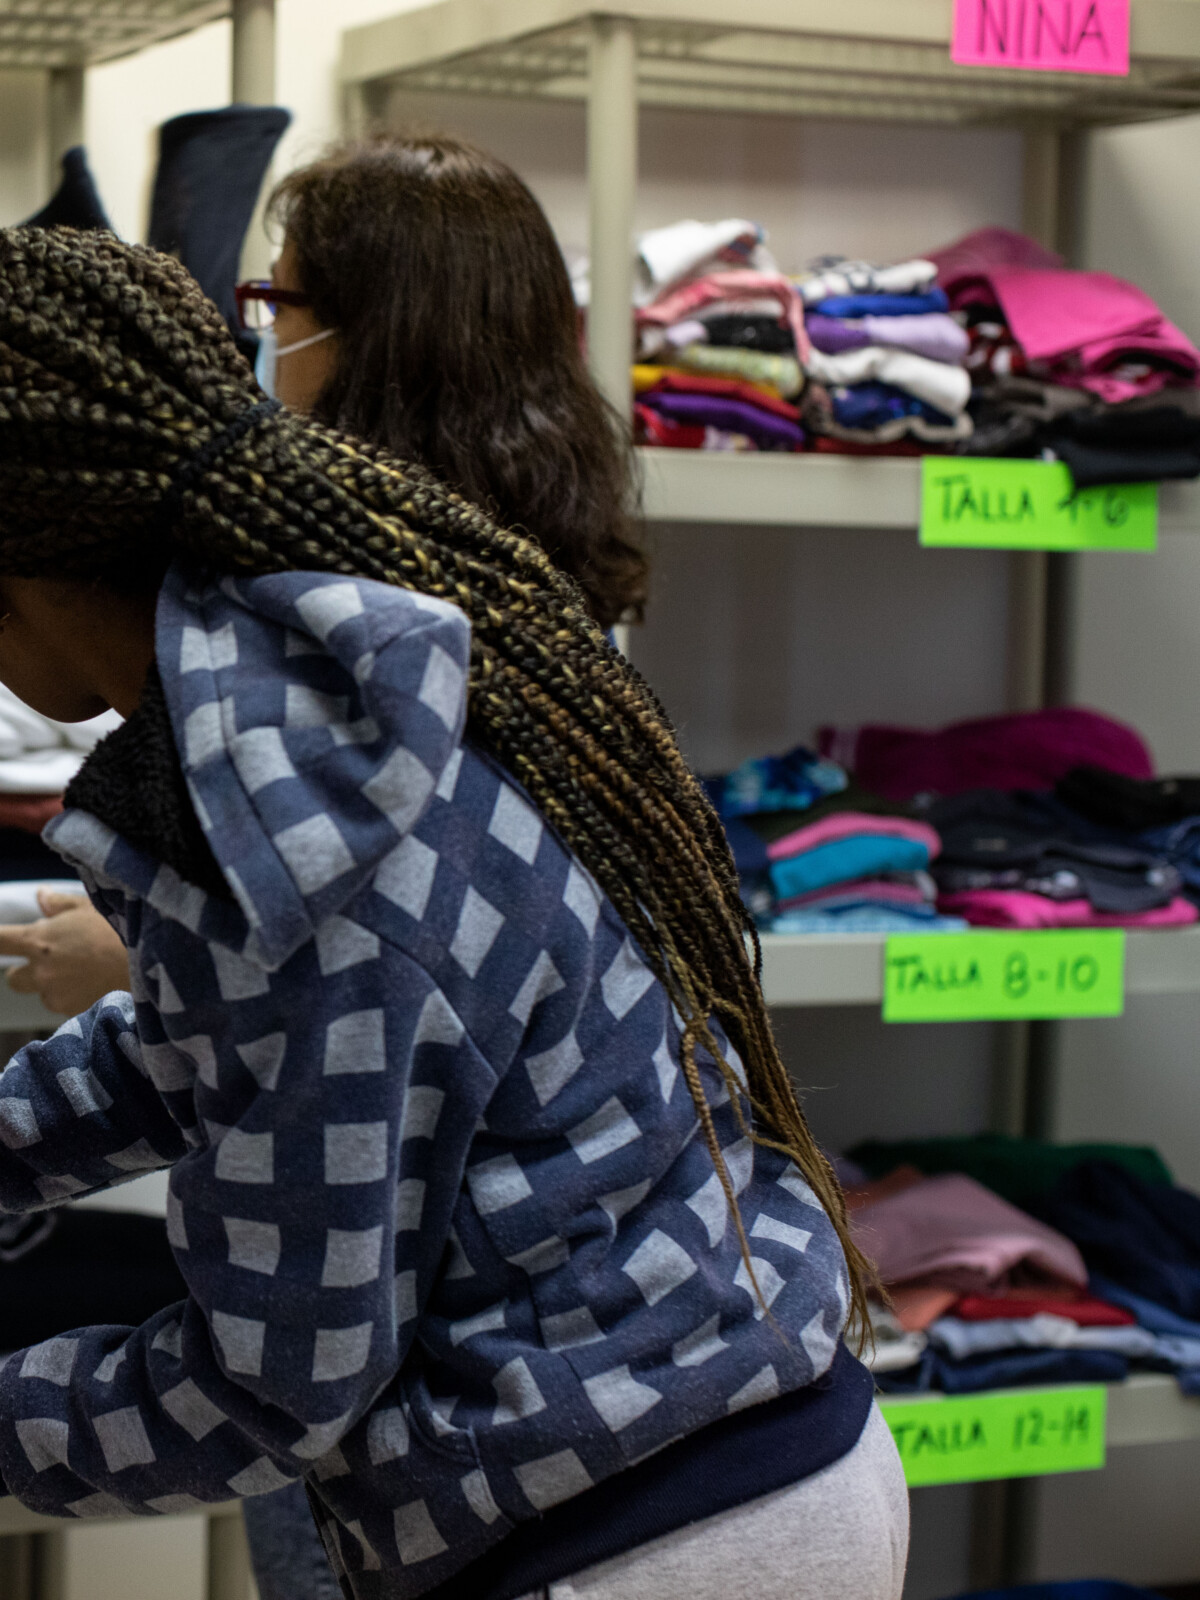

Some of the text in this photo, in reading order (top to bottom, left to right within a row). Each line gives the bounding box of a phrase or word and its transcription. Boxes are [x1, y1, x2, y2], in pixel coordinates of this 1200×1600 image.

[932, 472, 1035, 524] TALLA
[888, 950, 1100, 1000] TALLA 8-10
[891, 1415, 988, 1458] TALLA
